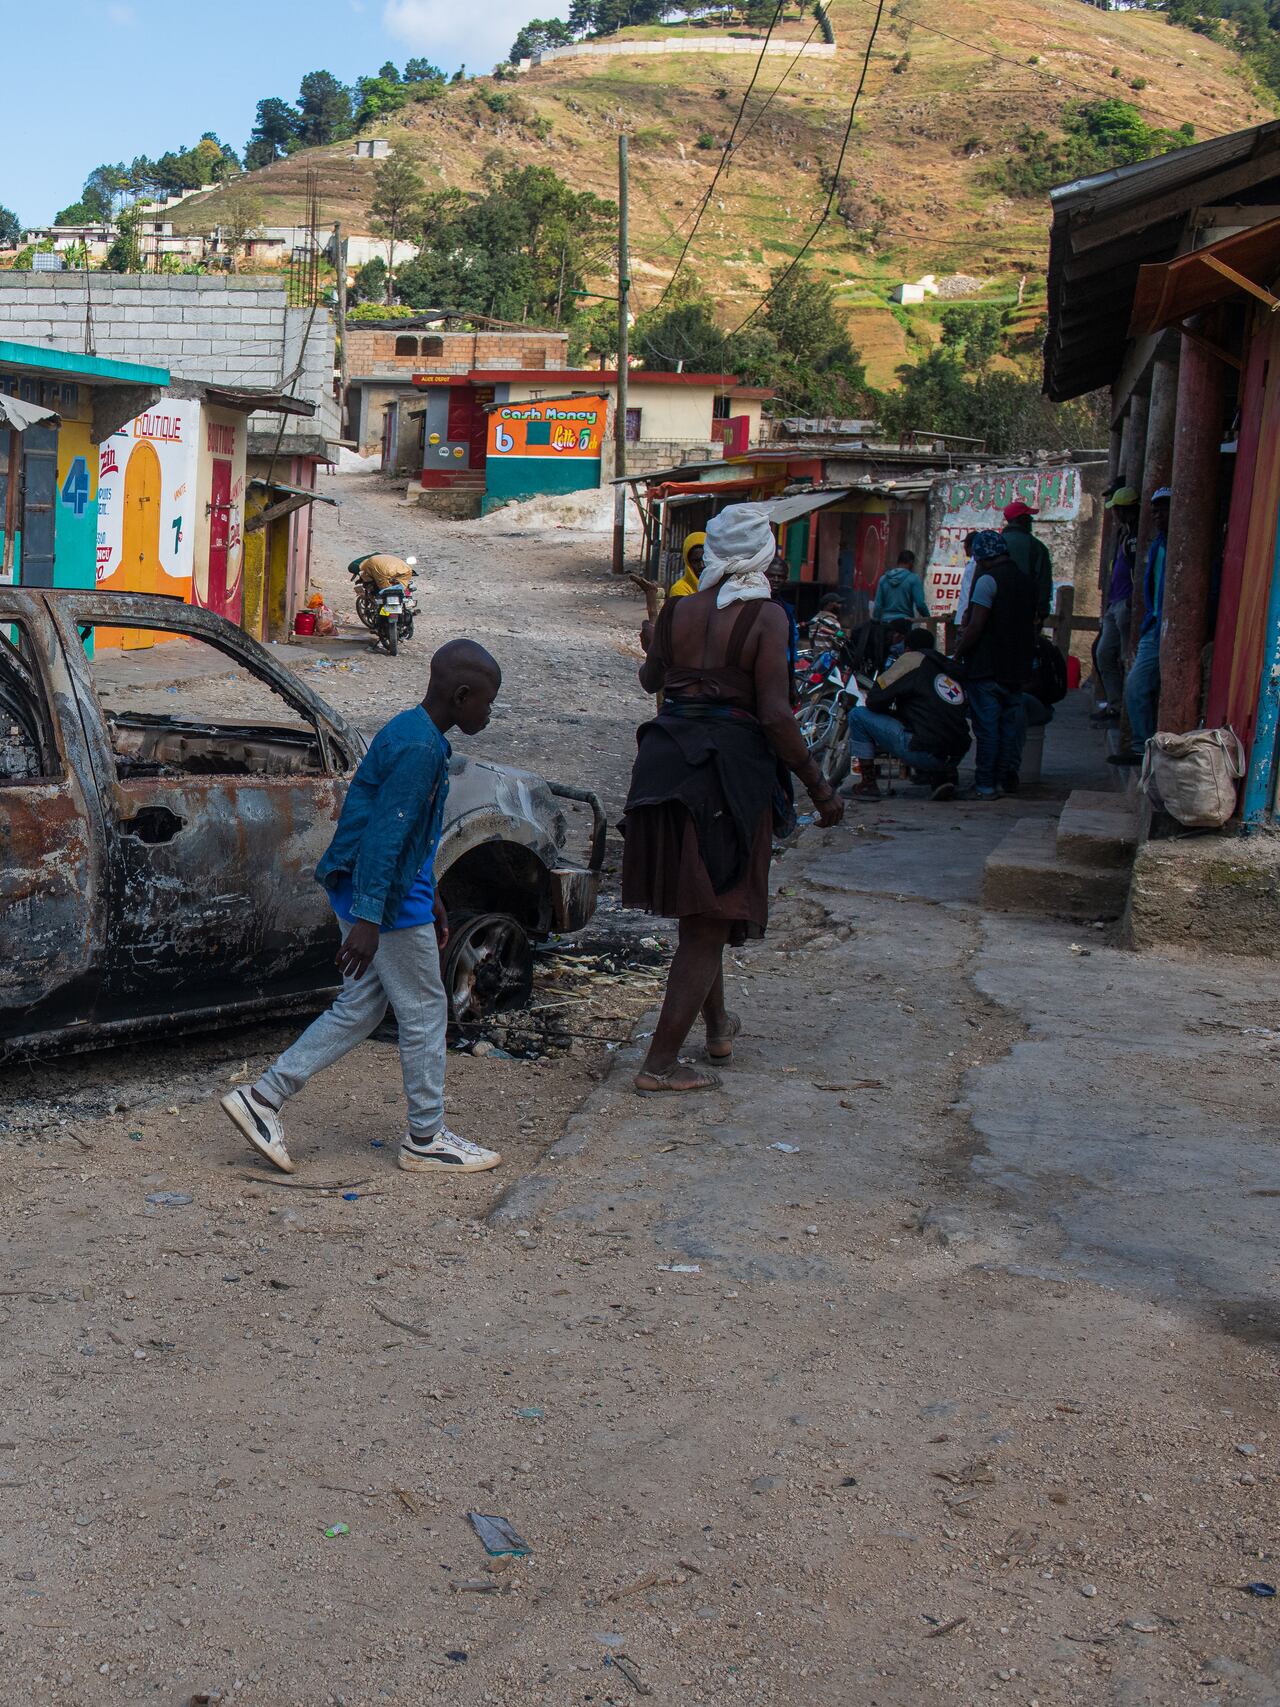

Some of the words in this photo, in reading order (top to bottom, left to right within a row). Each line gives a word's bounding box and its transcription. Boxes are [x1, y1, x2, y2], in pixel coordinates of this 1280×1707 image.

[134, 413, 181, 444] BOUTIQUE
[501, 408, 542, 420] Cash
[545, 408, 597, 425] Money
[552, 424, 578, 452] Lotto
[62, 459, 89, 514] 4
